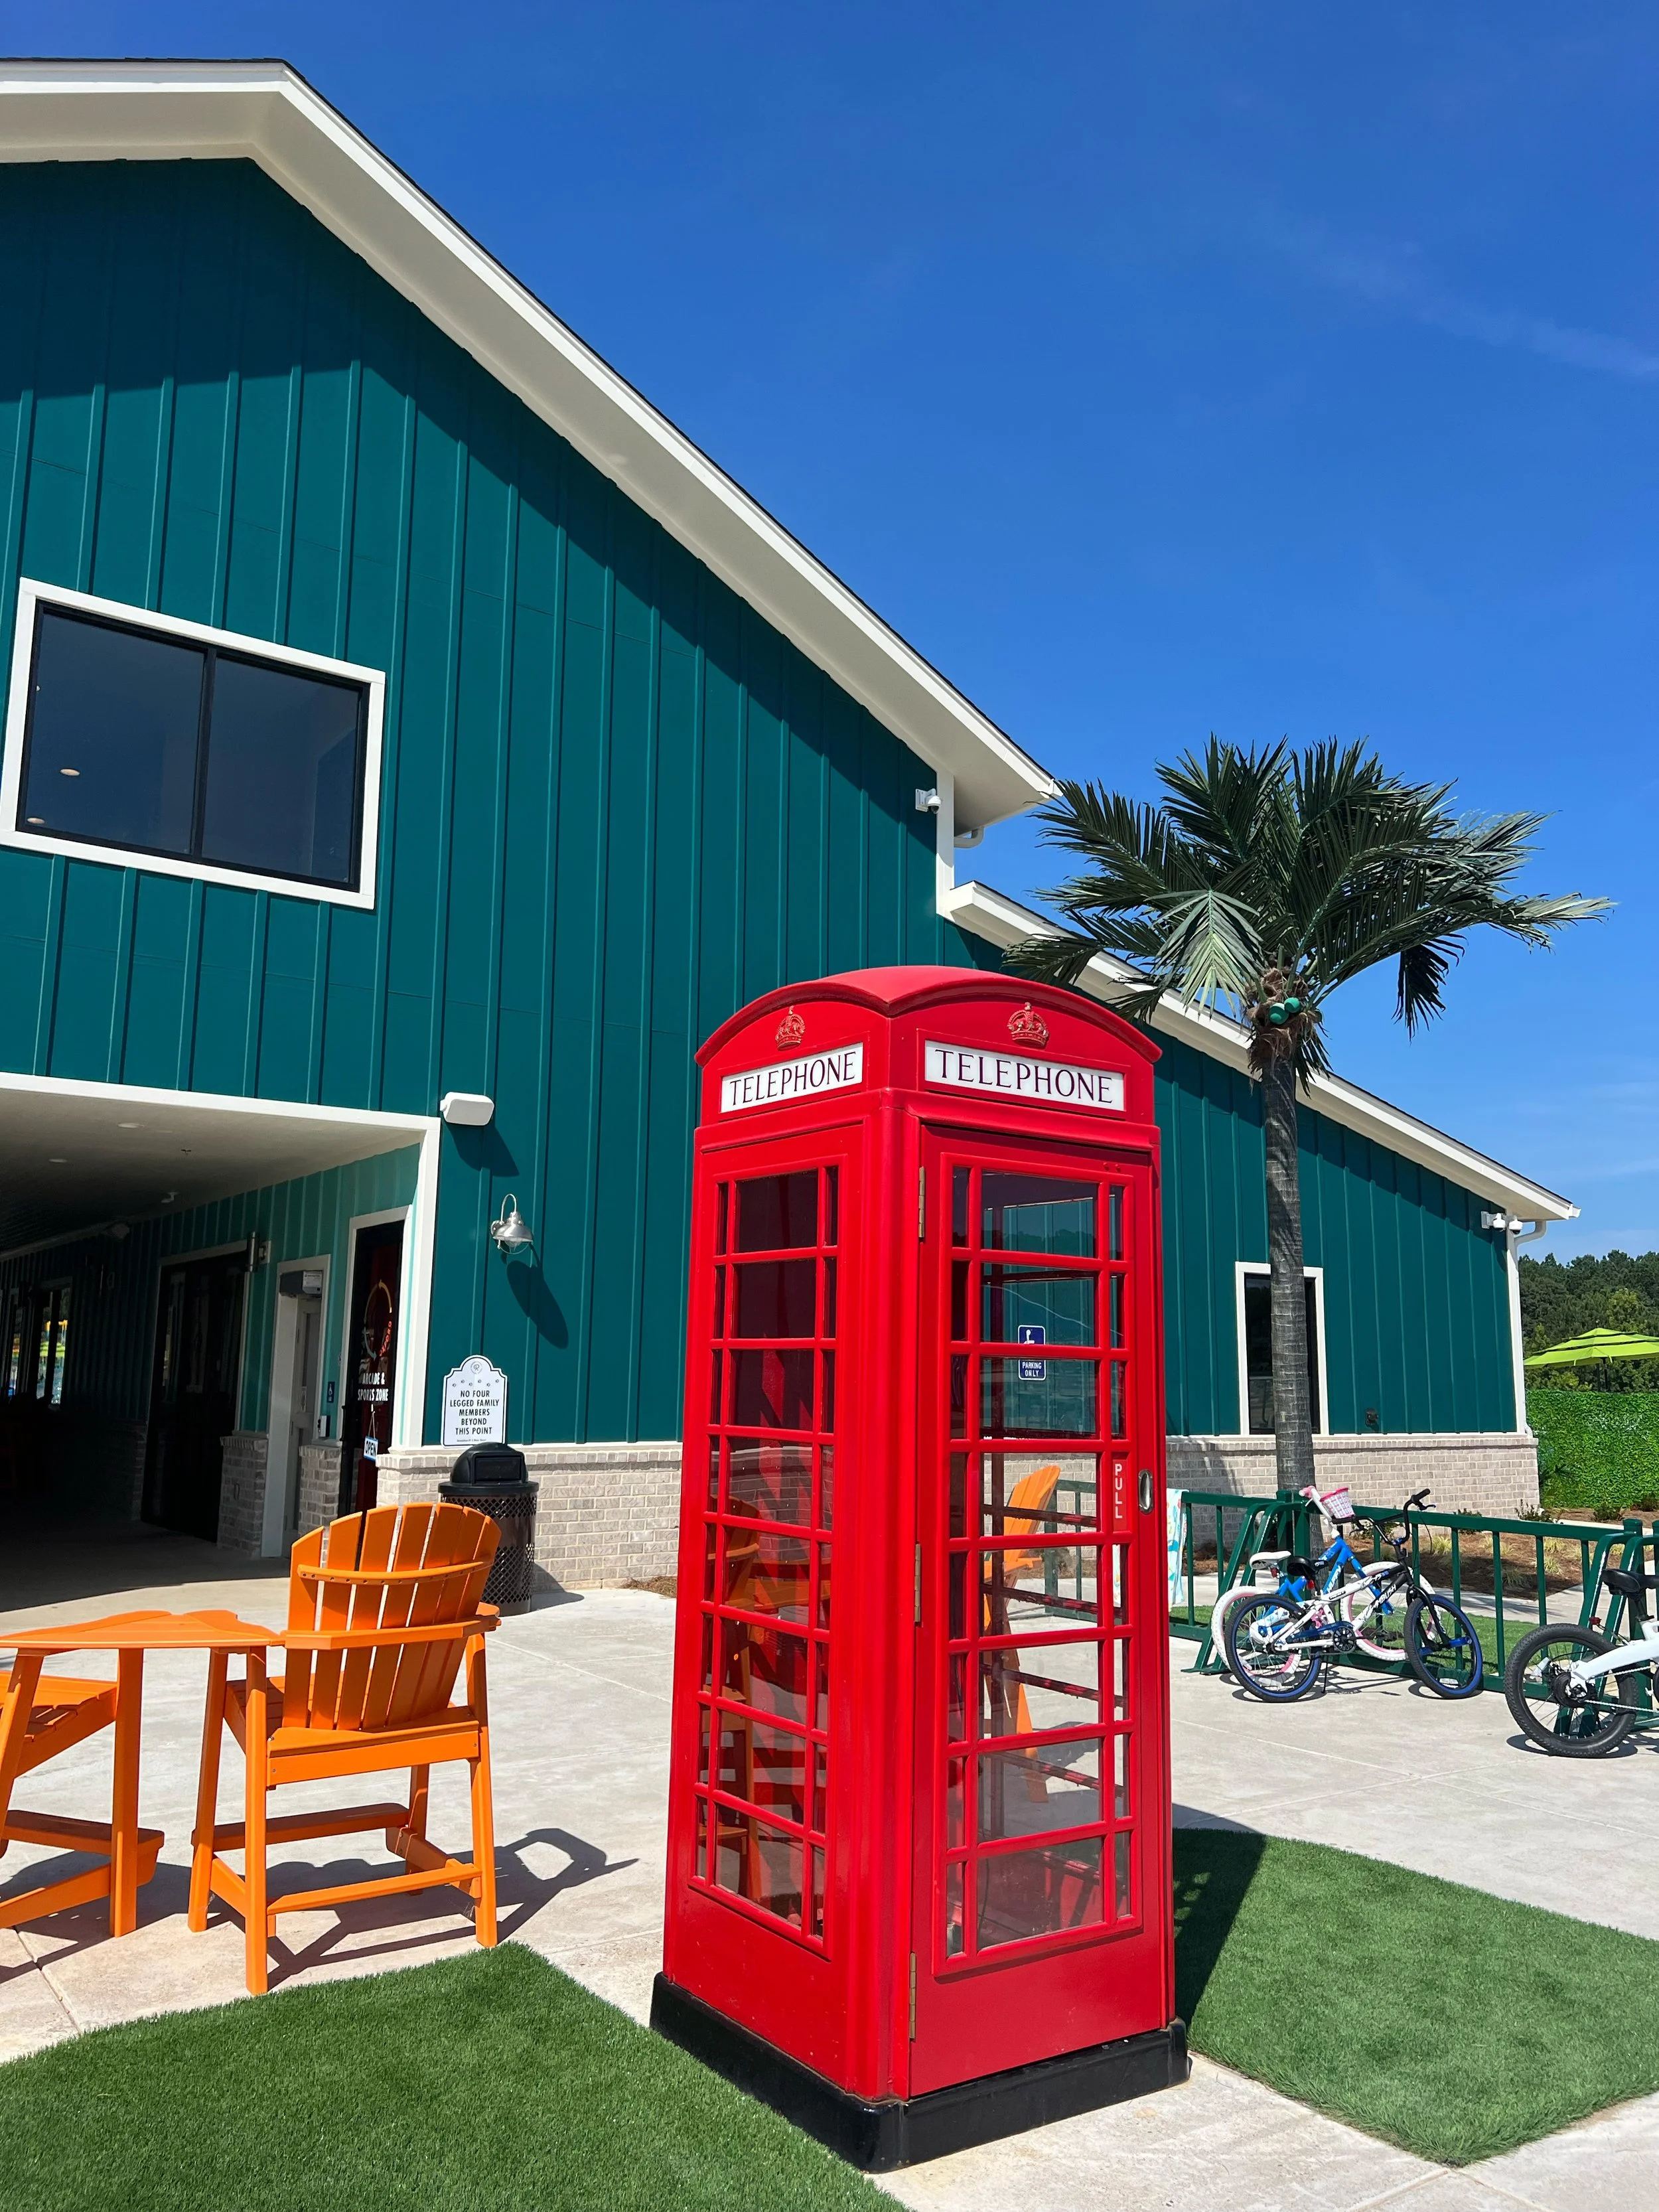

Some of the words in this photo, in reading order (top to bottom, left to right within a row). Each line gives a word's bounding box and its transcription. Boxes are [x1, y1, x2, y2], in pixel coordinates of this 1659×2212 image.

[729, 1051, 856, 1106] TELEPHONE
[934, 1049, 1114, 1104] TELEPHONE
[358, 1388, 375, 1401] SPORTS
[376, 1388, 389, 1402] ZONE
[362, 1372, 380, 1385] ARCADE
[381, 1372, 385, 1385] &
[365, 1440, 377, 1457] OPEN
[1114, 1463, 1123, 1519] PULL
